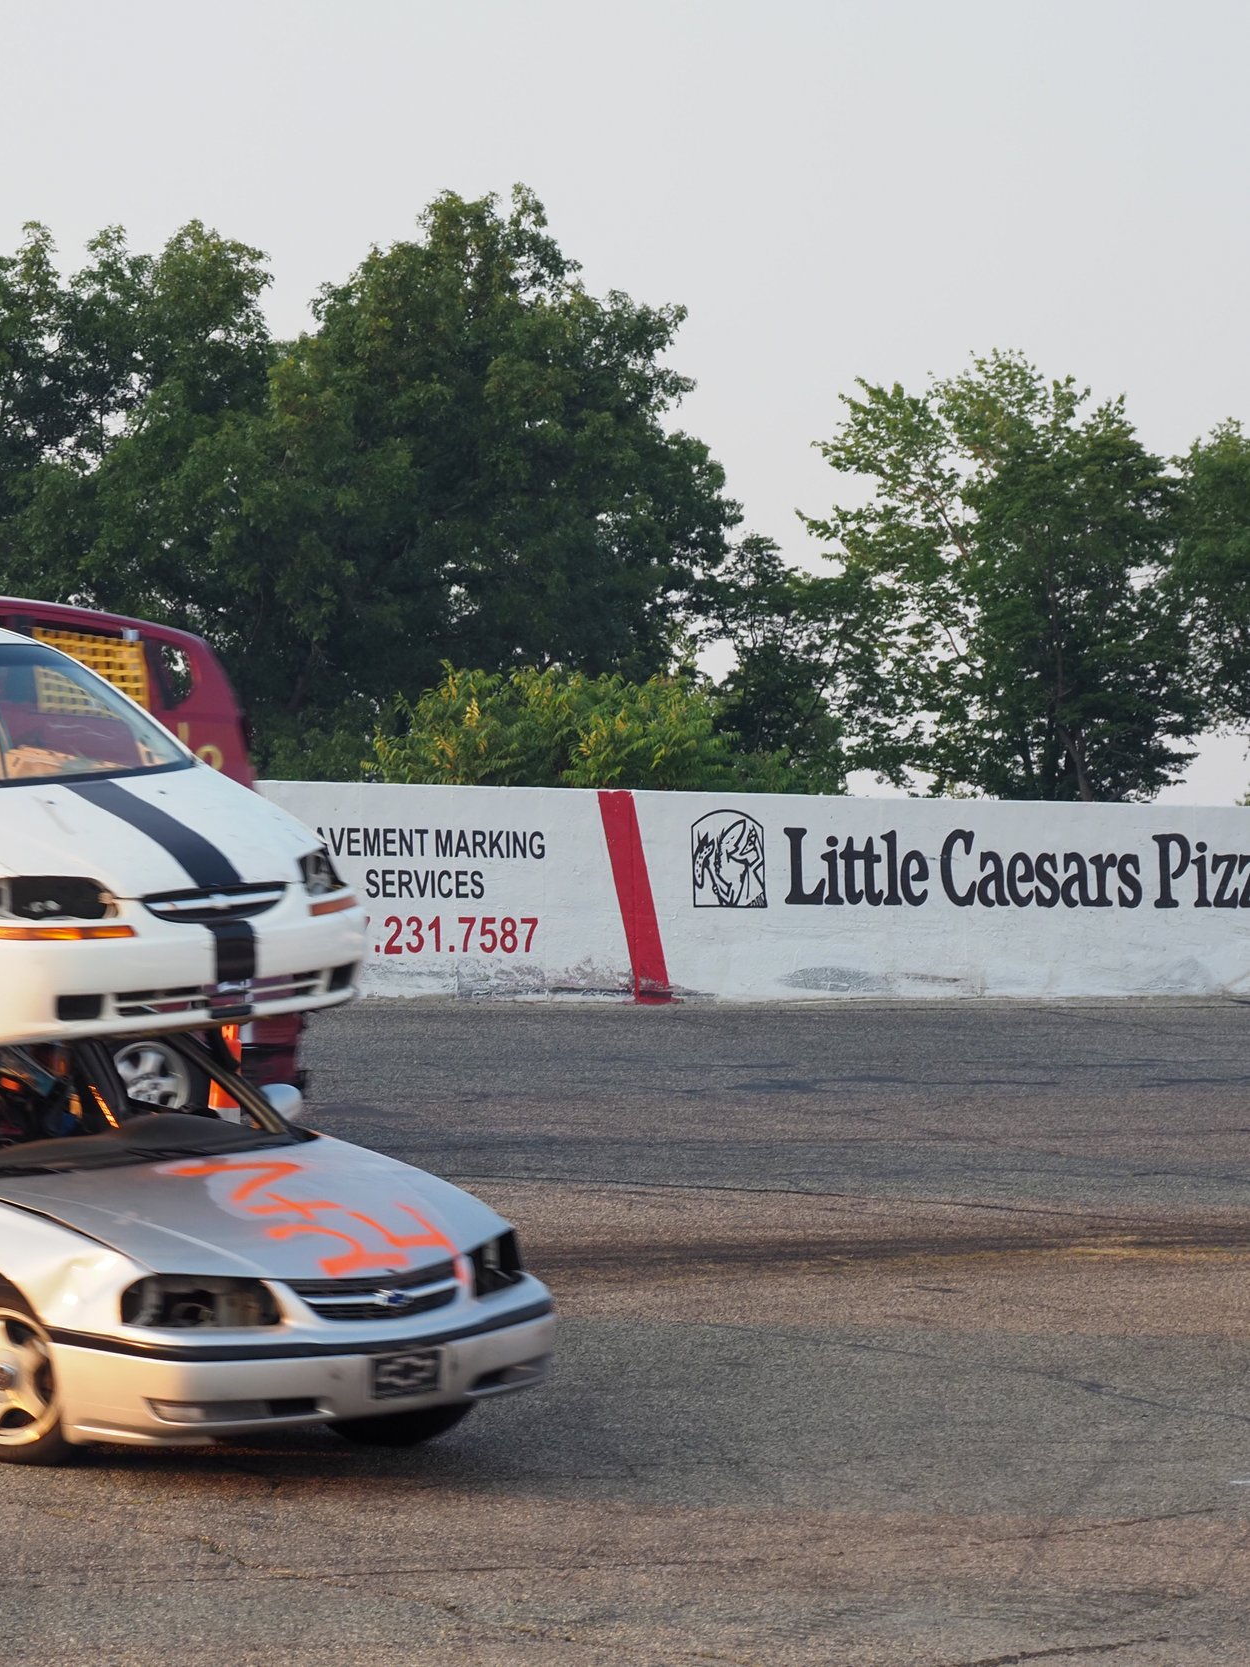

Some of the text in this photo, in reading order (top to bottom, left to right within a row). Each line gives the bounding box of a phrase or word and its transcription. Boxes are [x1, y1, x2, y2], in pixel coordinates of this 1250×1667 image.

[435, 829, 546, 859] MARKING
[365, 869, 485, 899] SERVICES
[783, 827, 929, 907] Little
[940, 829, 1142, 908] Caesars
[364, 915, 539, 955] .231.7587
